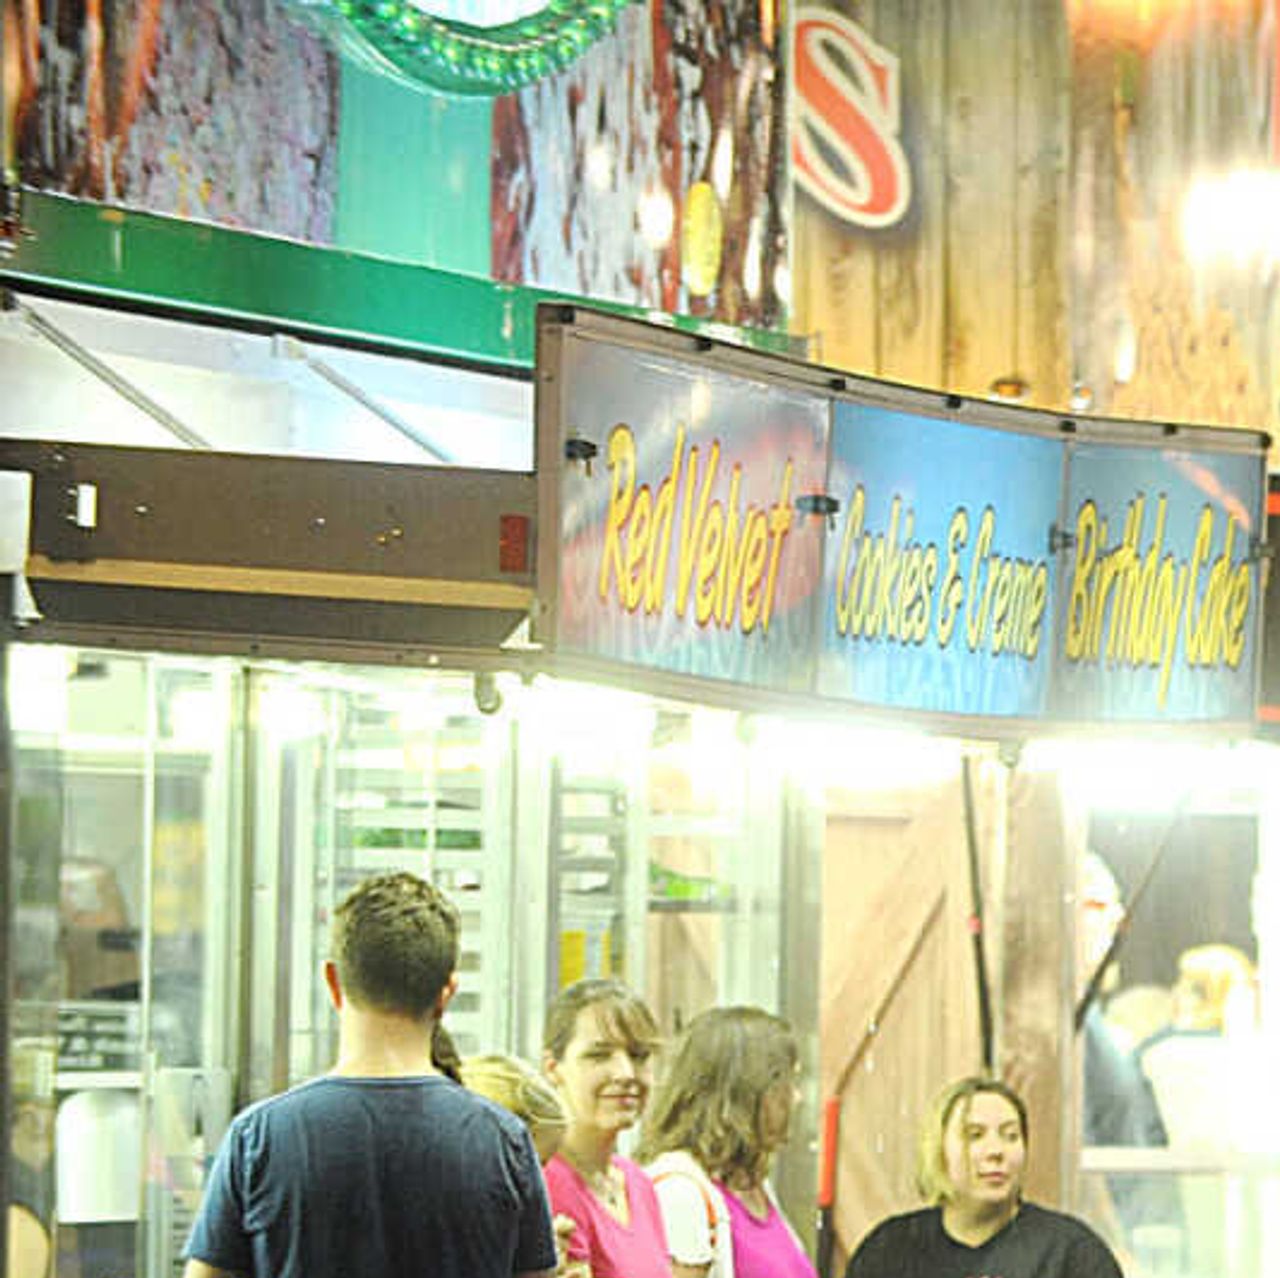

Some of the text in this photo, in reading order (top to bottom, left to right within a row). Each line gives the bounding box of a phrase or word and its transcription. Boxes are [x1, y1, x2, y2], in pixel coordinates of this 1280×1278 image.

[598, 420, 795, 640] Red Velvet
[836, 482, 1048, 661] Cookies & Creme
[1065, 490, 1250, 712] Birthday Cake
